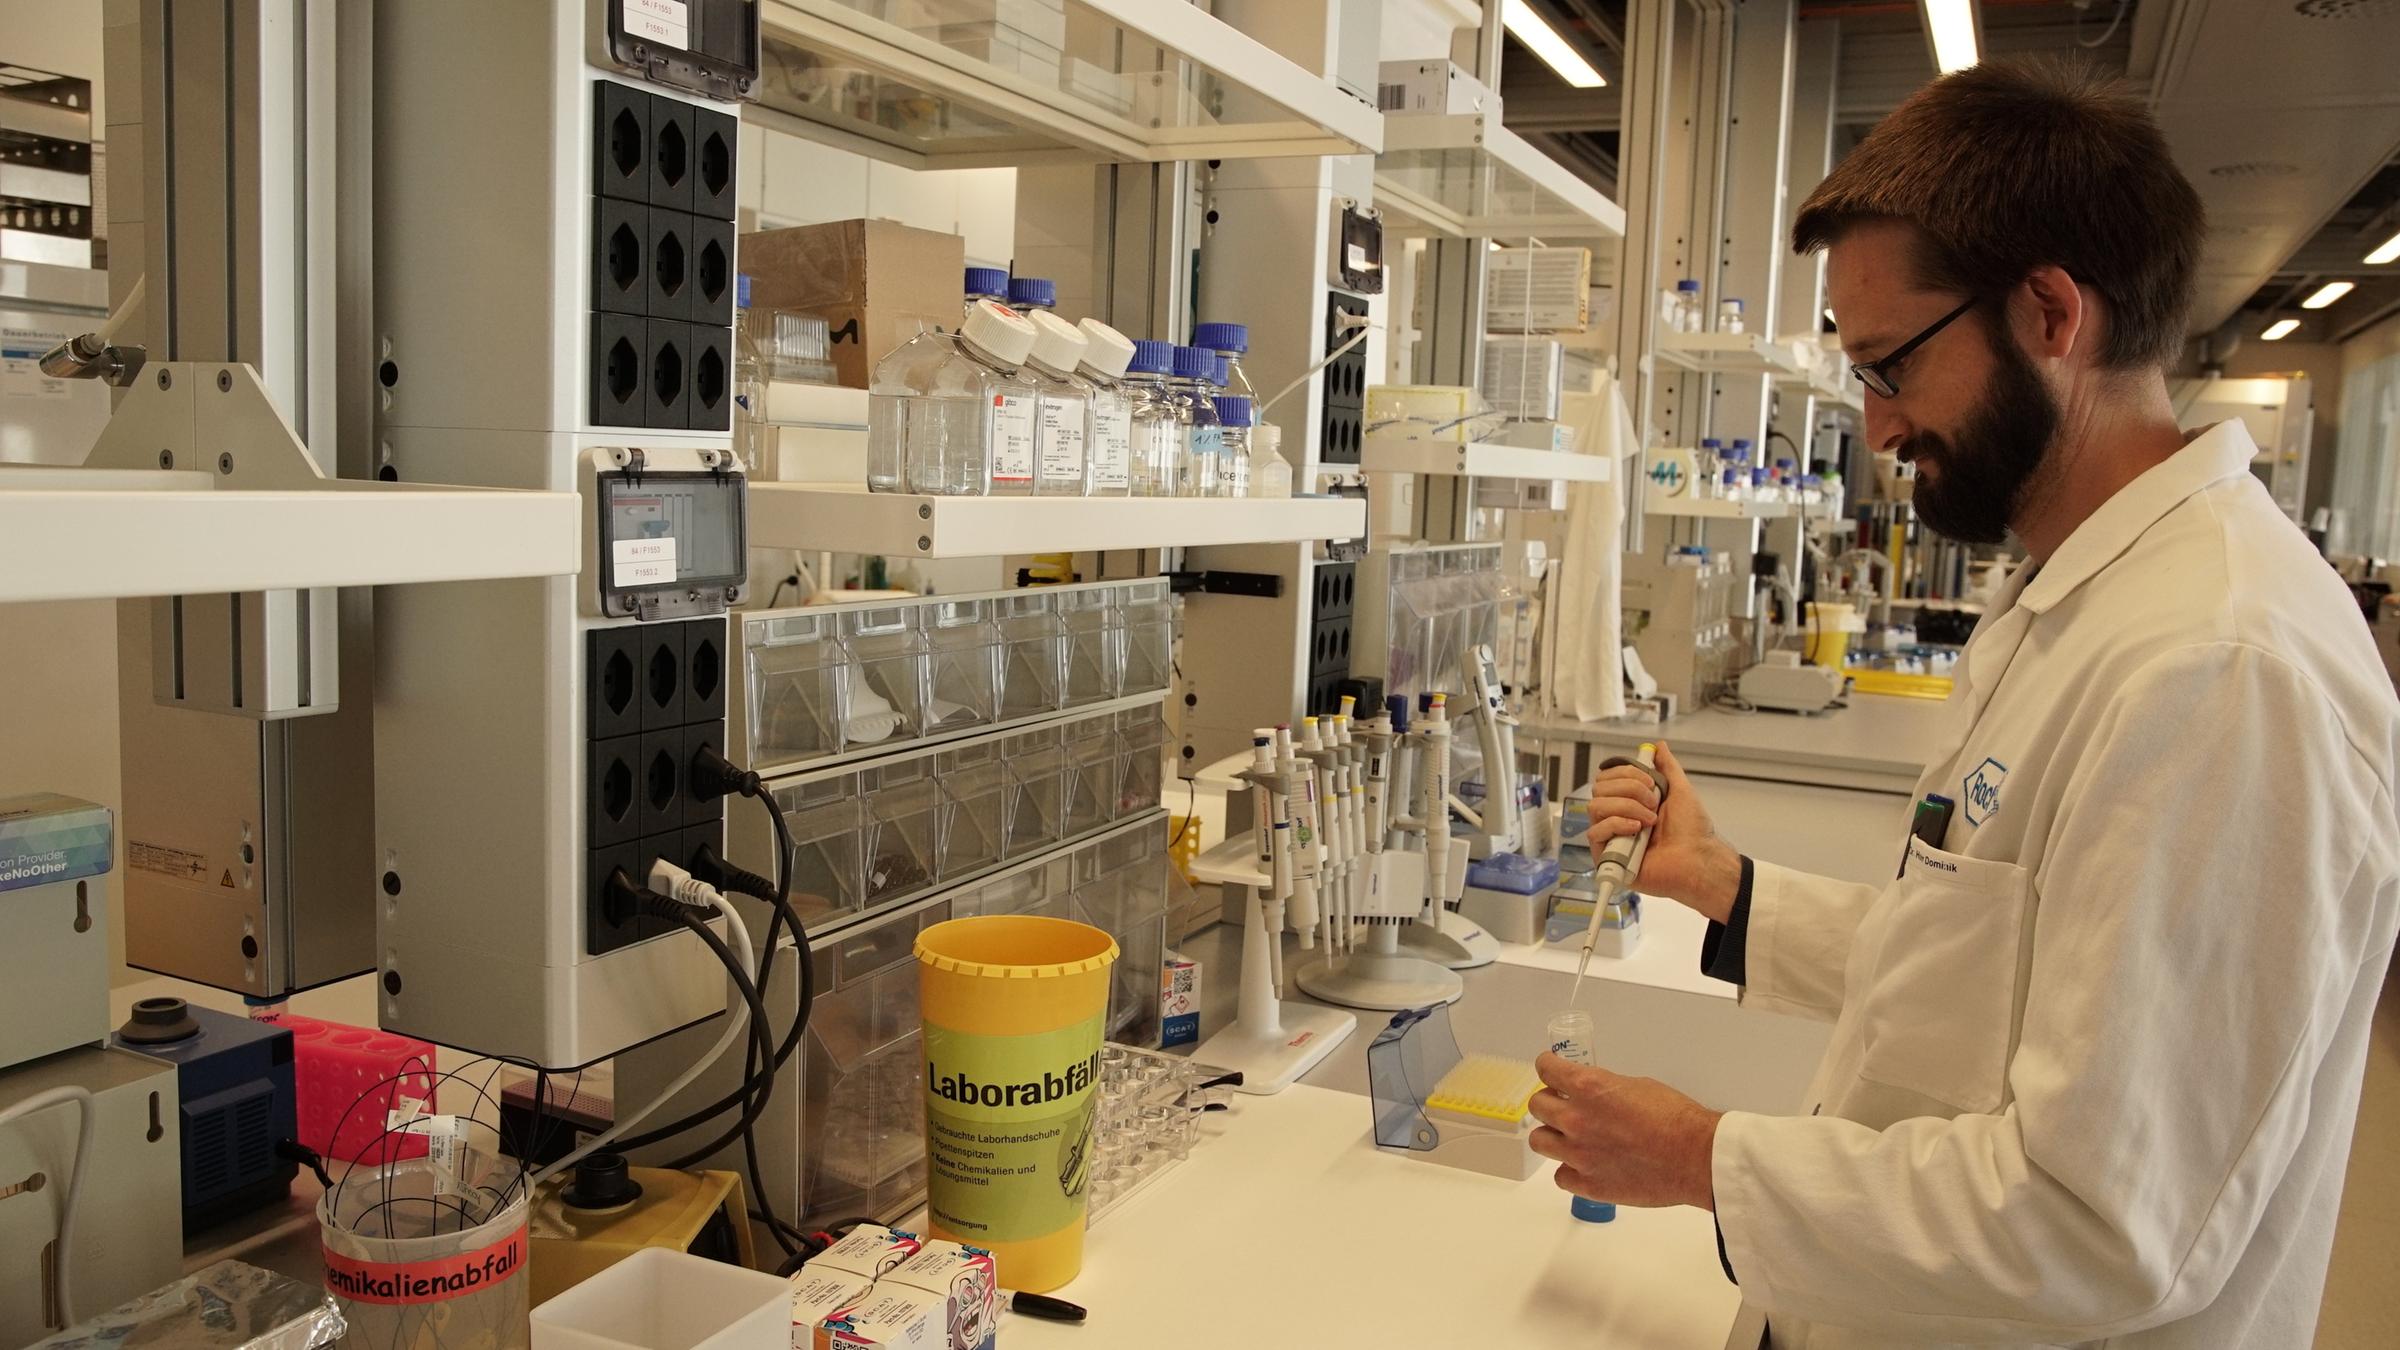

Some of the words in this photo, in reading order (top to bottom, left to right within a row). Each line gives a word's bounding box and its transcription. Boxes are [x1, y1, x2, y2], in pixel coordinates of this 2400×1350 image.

[18, 850, 67, 865] Provider.
[1925, 856, 1957, 873] Dominik
[1169, 1023, 1192, 1034] SCAT
[930, 1049, 1103, 1107] Laborabfäll
[934, 1120, 976, 1143] Gebrauchte
[977, 1127, 1061, 1145] Laborhandschuhe
[934, 1138, 995, 1161] Pipettenspitzen
[935, 1153, 956, 1170] Keine
[957, 1163, 1015, 1176] Chemikalien
[1017, 1164, 1036, 1175] und
[935, 1164, 989, 1187] Lösungsmittel
